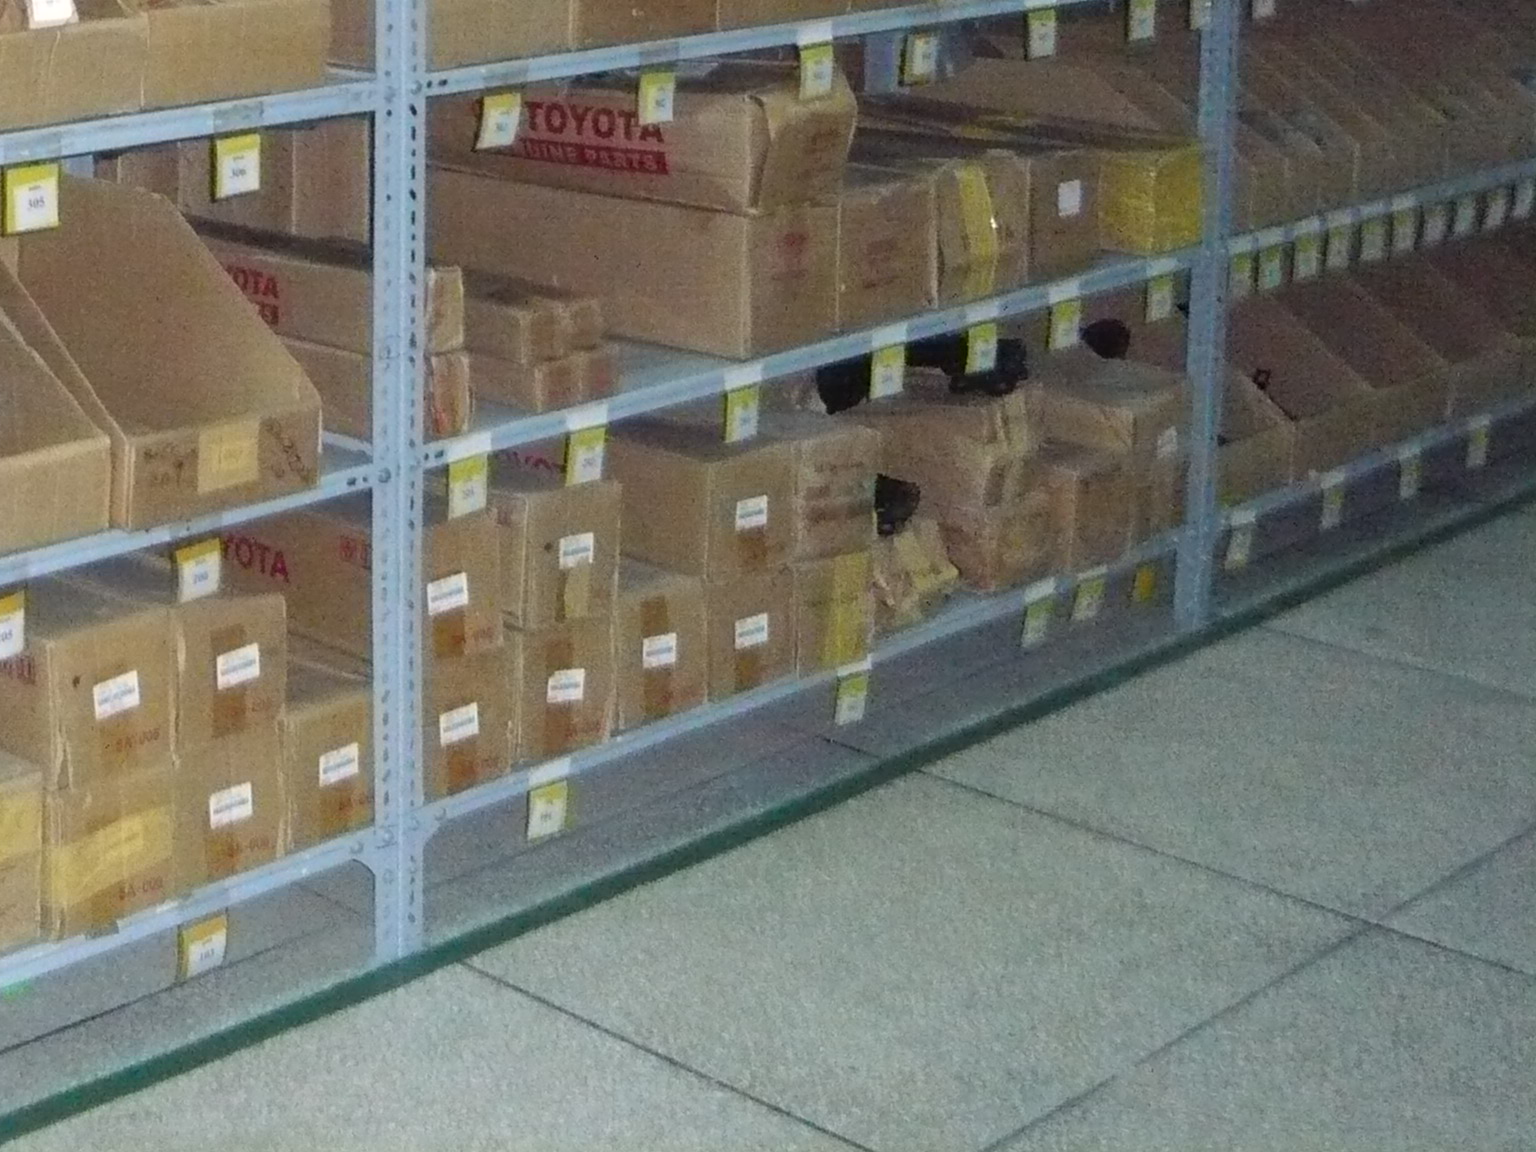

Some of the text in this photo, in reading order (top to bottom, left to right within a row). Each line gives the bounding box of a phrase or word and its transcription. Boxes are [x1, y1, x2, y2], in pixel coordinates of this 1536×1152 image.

[525, 101, 665, 144] TOYOTA
[582, 148, 658, 172] PARTS
[26, 195, 47, 211] 305
